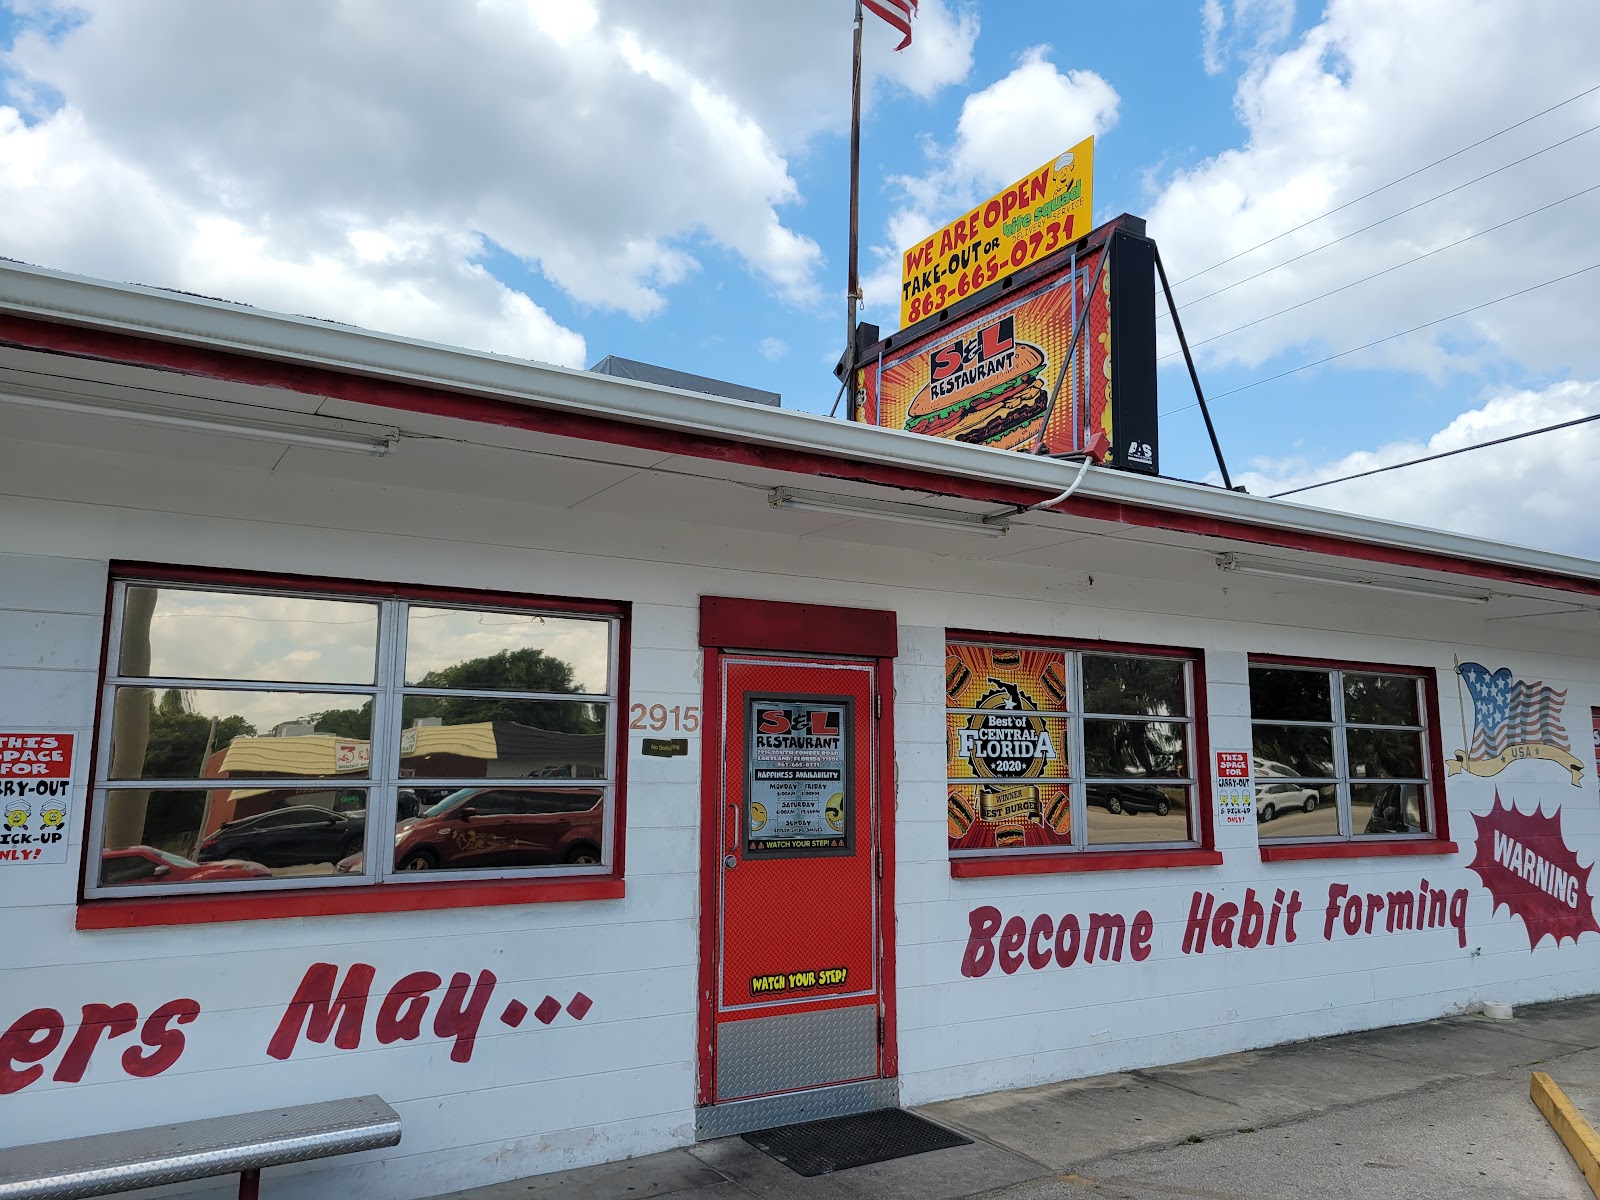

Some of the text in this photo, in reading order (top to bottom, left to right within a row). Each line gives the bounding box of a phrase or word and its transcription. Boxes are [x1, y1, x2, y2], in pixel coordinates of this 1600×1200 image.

[1002, 179, 1082, 238] bite squad
[906, 168, 1050, 277] WE ARE OPEN
[1012, 199, 1084, 243] DELIVERY SERVICE
[903, 237, 1000, 302] TAKE-OUT OR
[908, 214, 1075, 323] 863-665-0731
[931, 352, 1015, 400] RESTAURANT
[630, 703, 699, 732] 2915
[988, 716, 1027, 727] Best of
[979, 728, 1038, 740] CENTRAL
[756, 736, 840, 749] RESTAURANT
[958, 730, 1056, 758] FLORIDA
[0, 750, 63, 761] PACE
[1511, 745, 1532, 759] USA
[1, 763, 49, 774] FOR
[996, 760, 1022, 772] 2020
[757, 771, 838, 779] HAPPINESS AVAILABILITY
[1218, 778, 1250, 788] CARRY-OUT
[0, 780, 69, 796] RY-OUT
[996, 789, 1023, 803] WINNER
[981, 801, 1039, 818] BEST BURGER
[766, 839, 830, 849] WATCH YOUR STEP!
[1493, 828, 1579, 909] WARNING
[961, 877, 1469, 978] Become Habit Forming
[752, 968, 847, 992] WATCH YOUR STEP!
